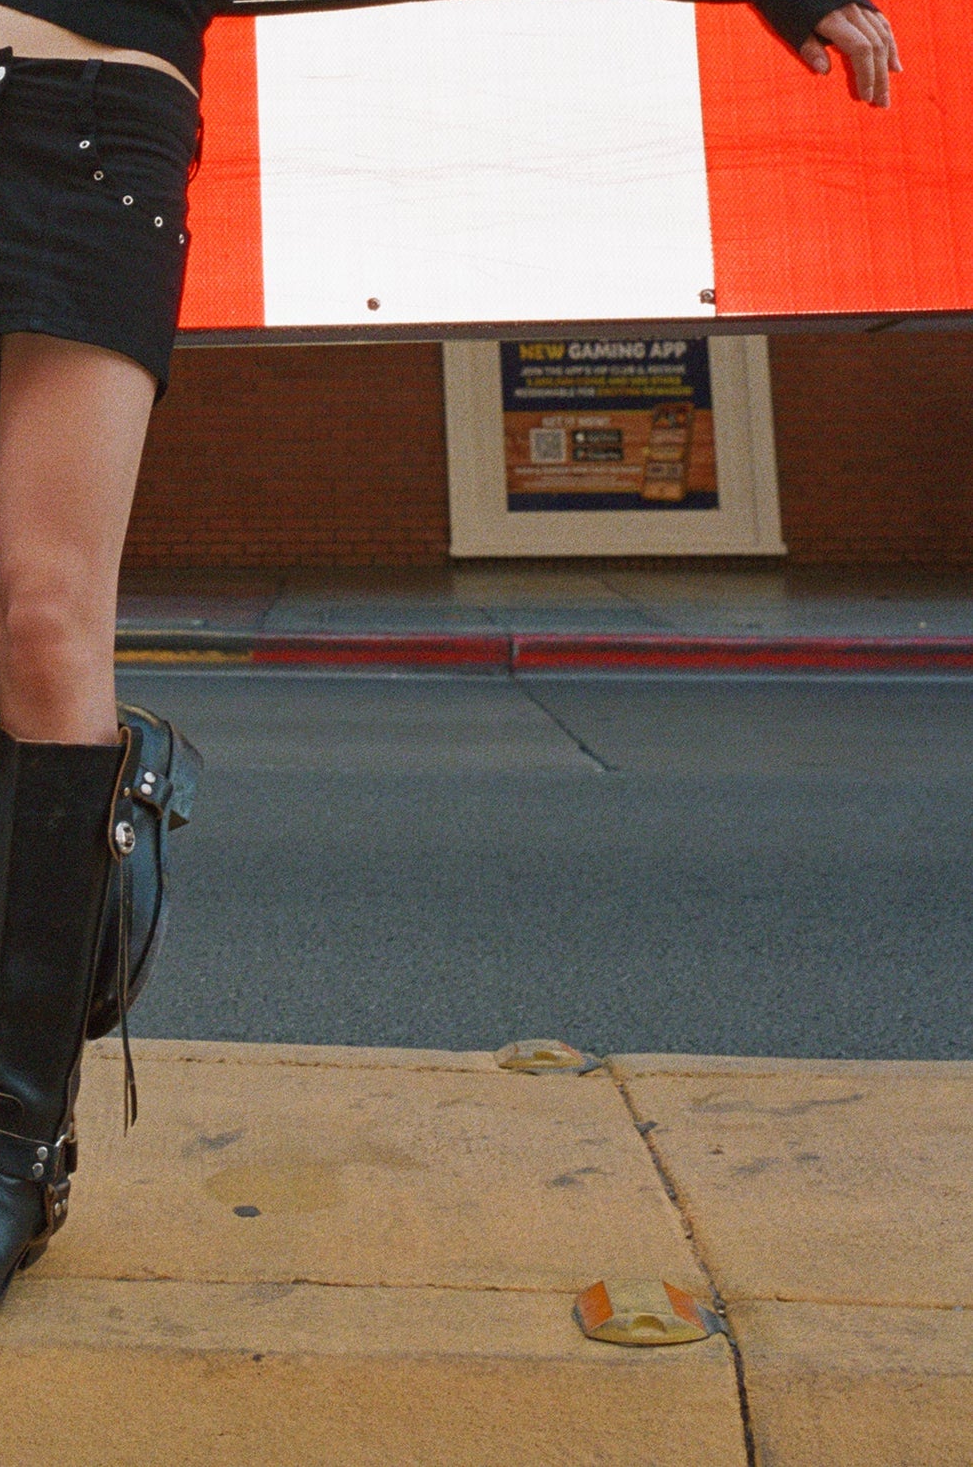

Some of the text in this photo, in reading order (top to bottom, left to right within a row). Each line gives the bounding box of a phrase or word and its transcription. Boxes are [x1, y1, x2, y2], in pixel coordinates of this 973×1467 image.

[518, 341, 687, 360] NEW GAMING APP
